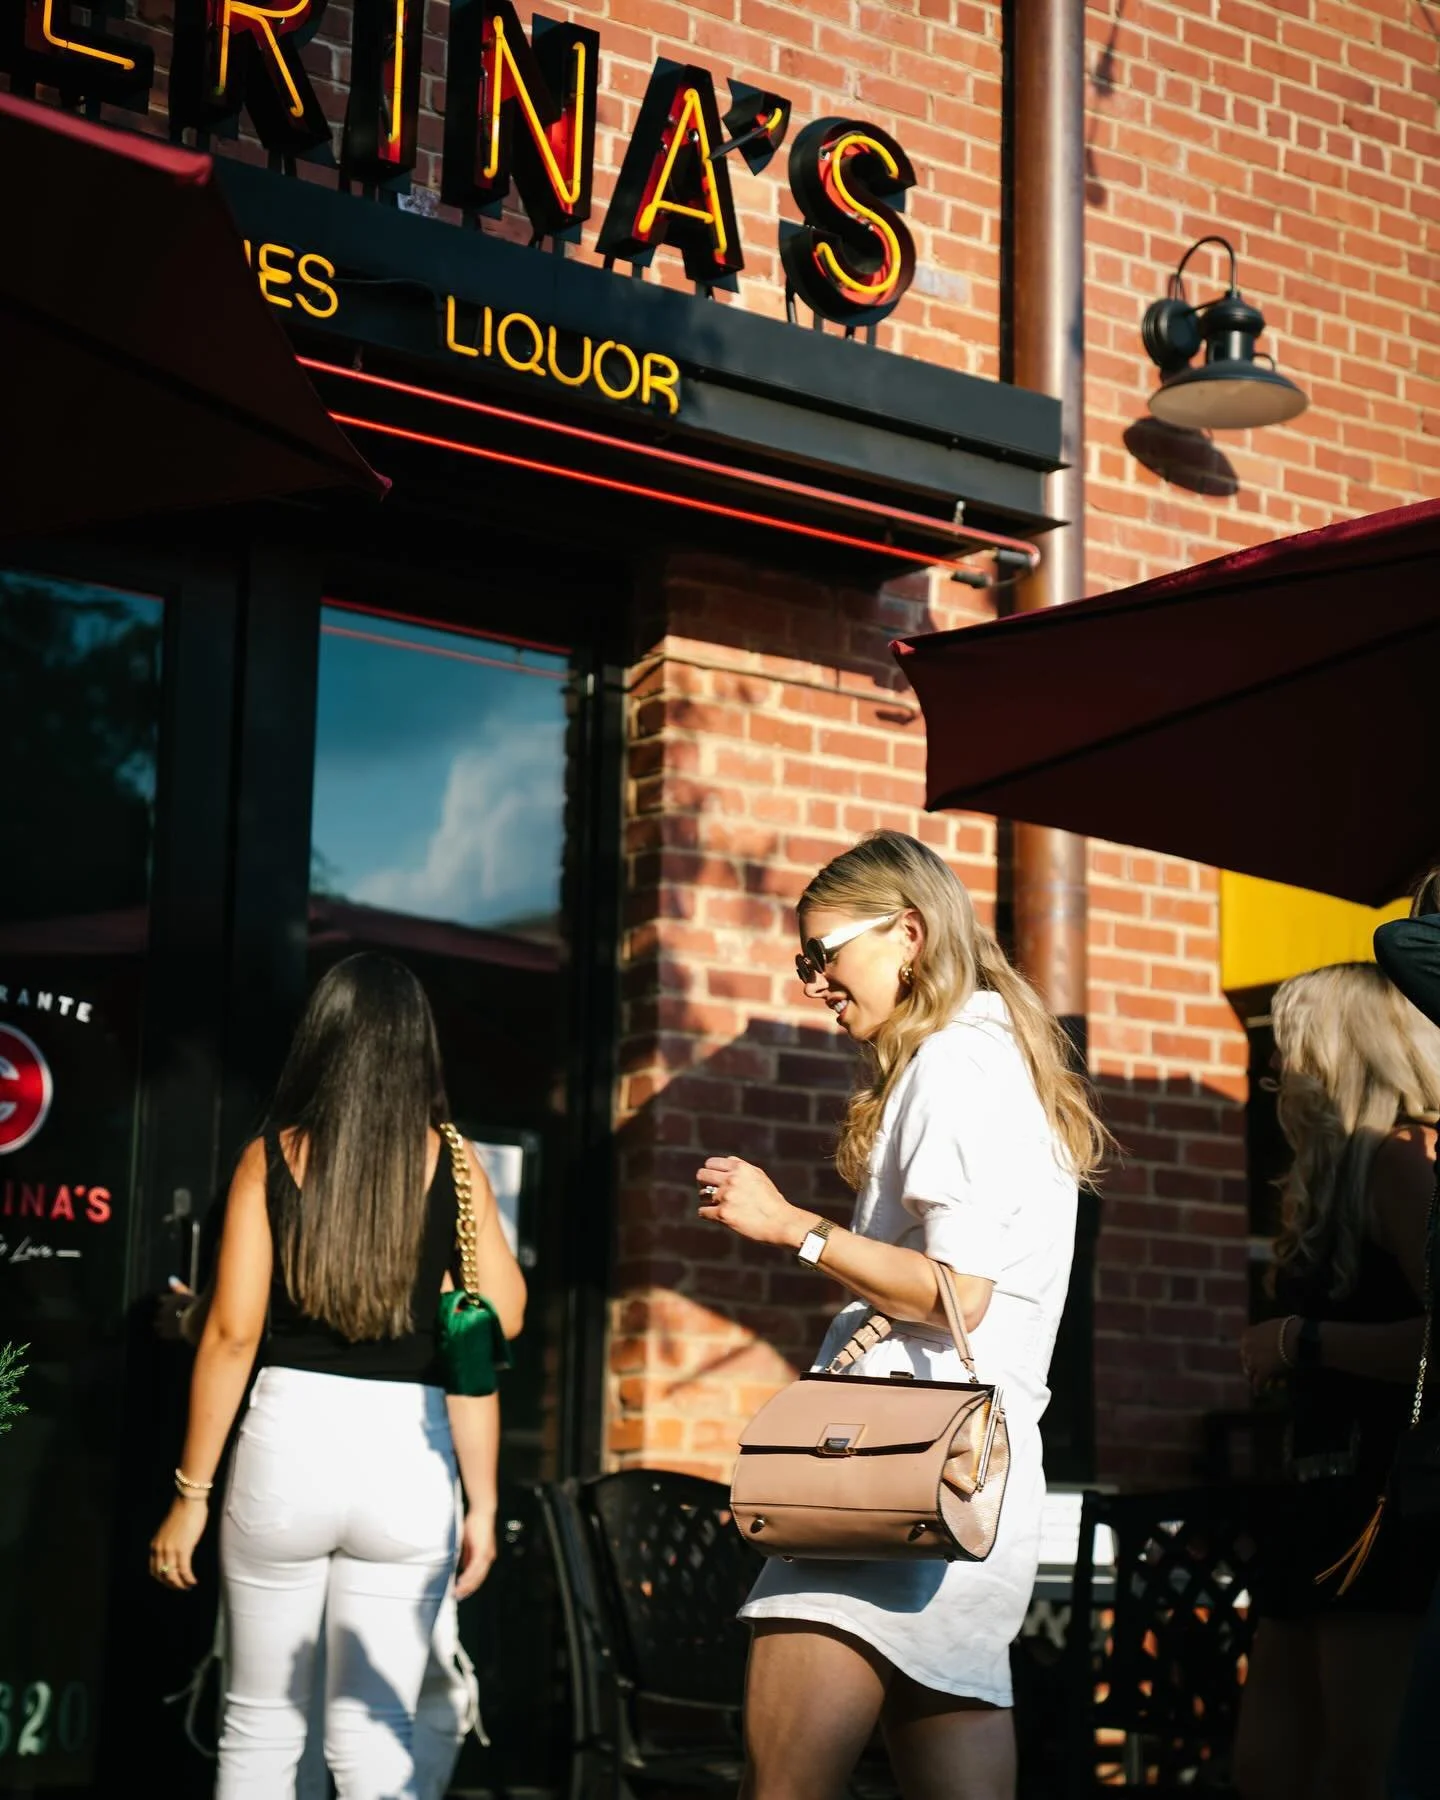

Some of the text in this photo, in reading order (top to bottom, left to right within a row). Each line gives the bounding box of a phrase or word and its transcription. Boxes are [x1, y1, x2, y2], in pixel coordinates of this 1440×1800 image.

[18, 0, 916, 326] RINA'S
[243, 239, 679, 415] ES LIQUOR
